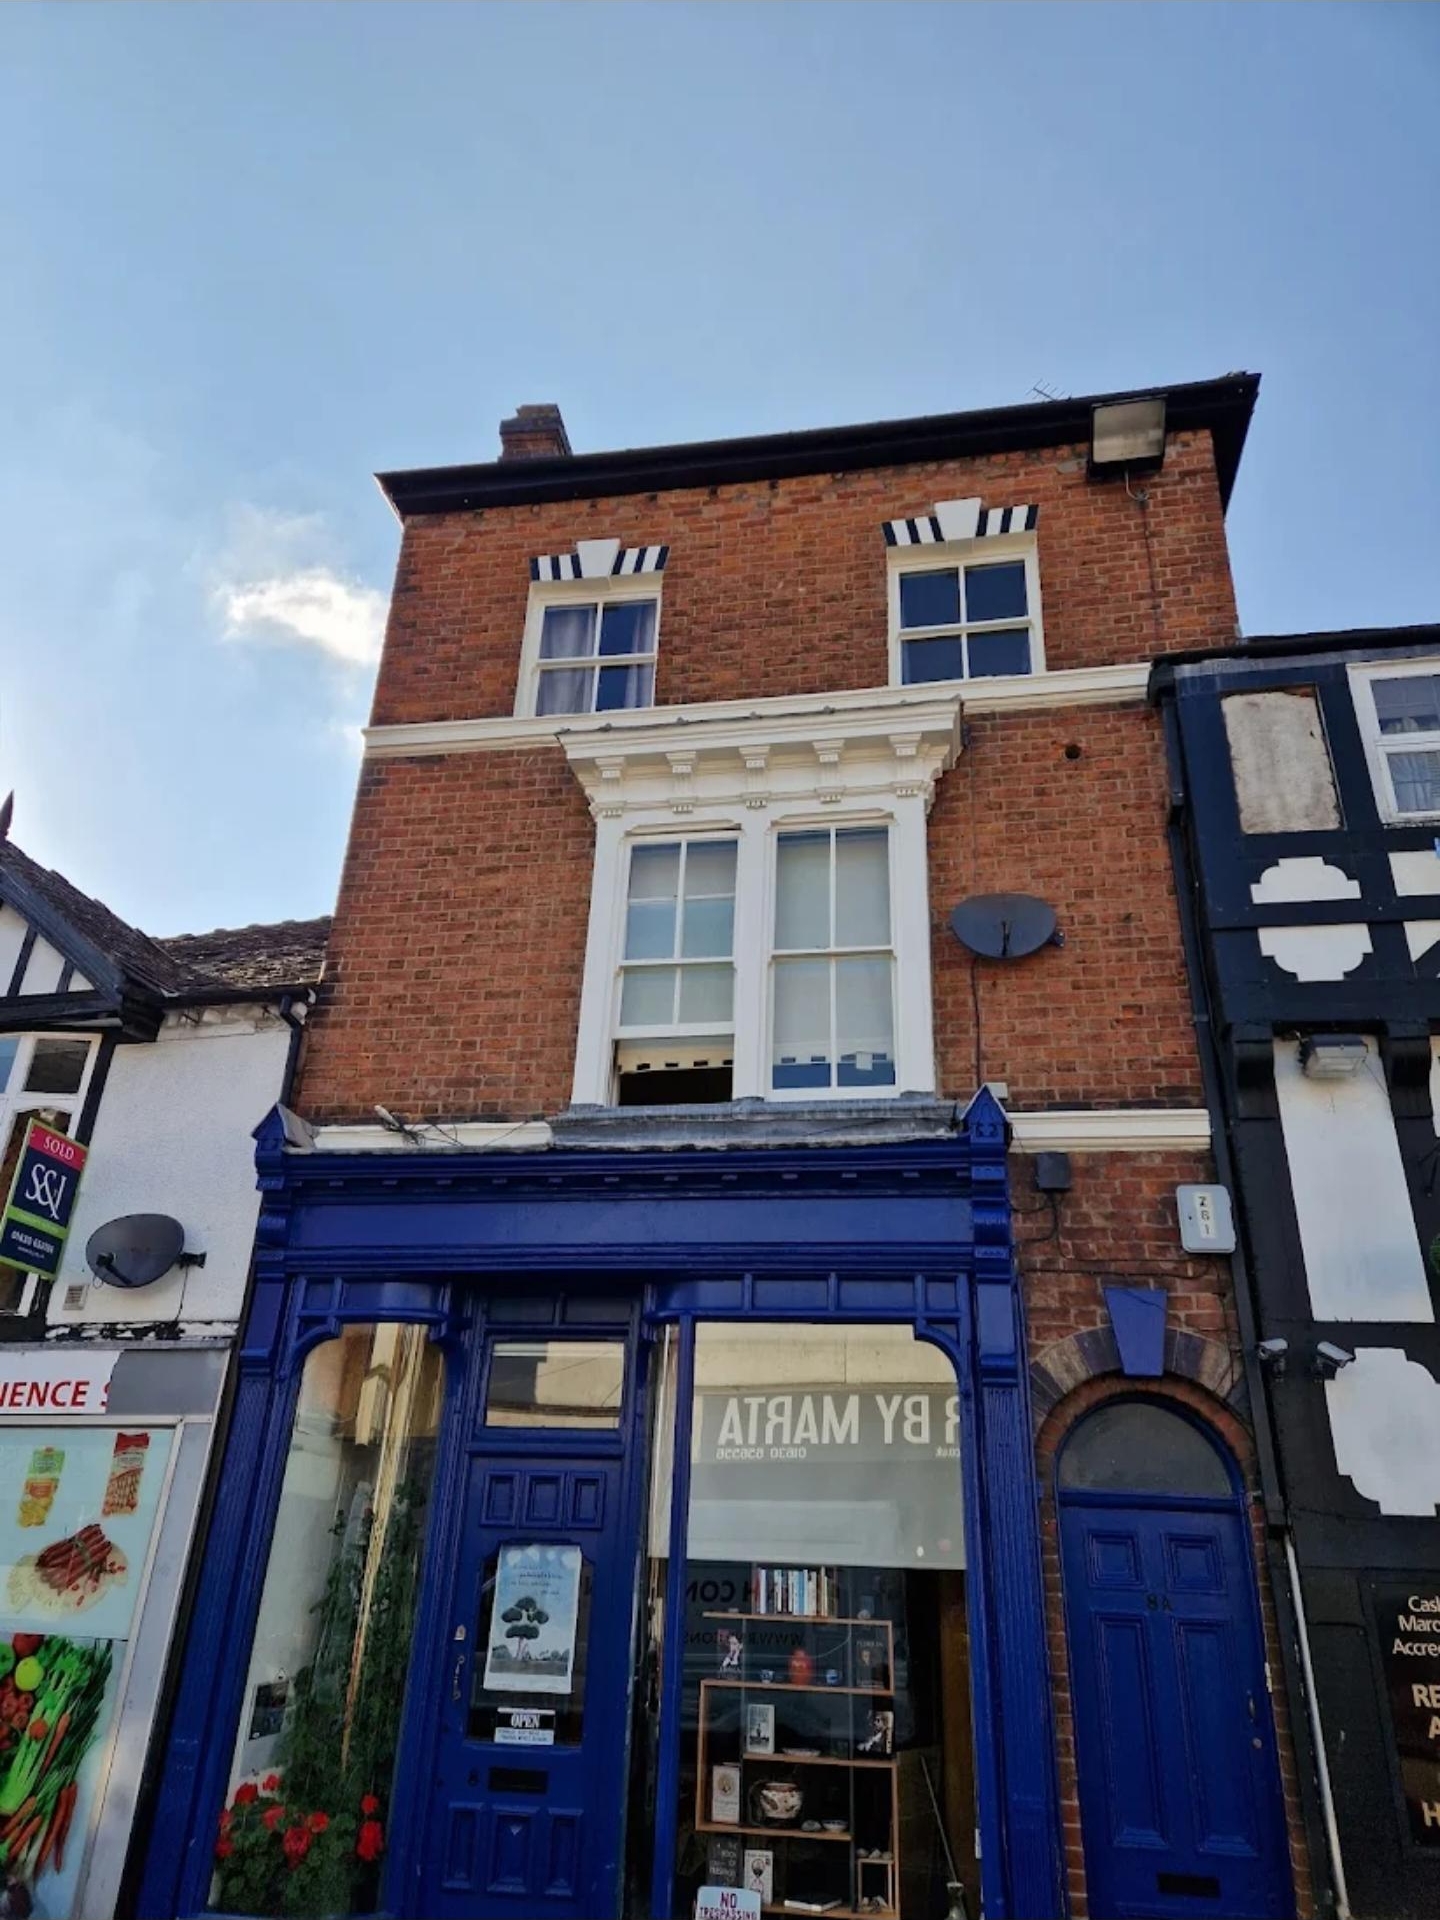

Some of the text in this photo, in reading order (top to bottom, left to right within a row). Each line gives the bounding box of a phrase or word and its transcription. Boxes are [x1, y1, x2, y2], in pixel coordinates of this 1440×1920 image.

[43, 1136, 74, 1161] SOLD
[1392, 1637, 1440, 1657] Accre
[511, 1713, 540, 1729] OPEN
[721, 1892, 737, 1908] NO
